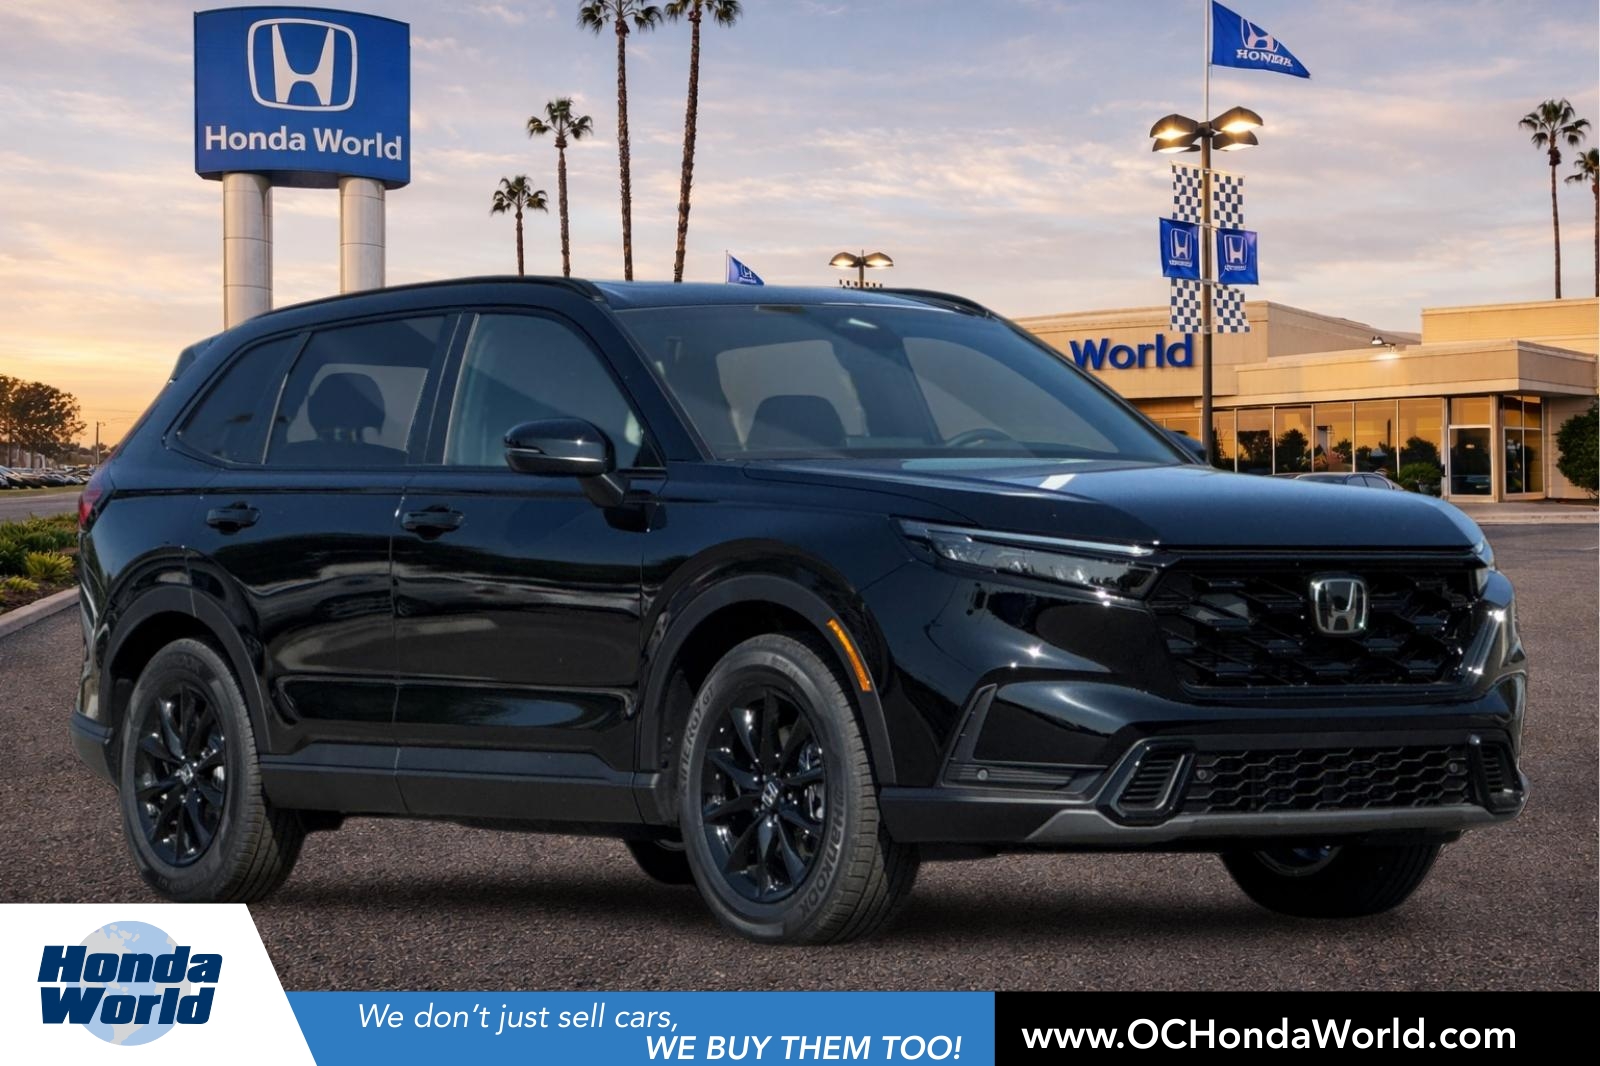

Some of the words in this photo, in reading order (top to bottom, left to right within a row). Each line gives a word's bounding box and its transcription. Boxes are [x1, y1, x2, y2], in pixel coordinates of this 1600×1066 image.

[205, 126, 306, 151] Honda
[313, 128, 402, 161] World
[1069, 333, 1194, 371] World
